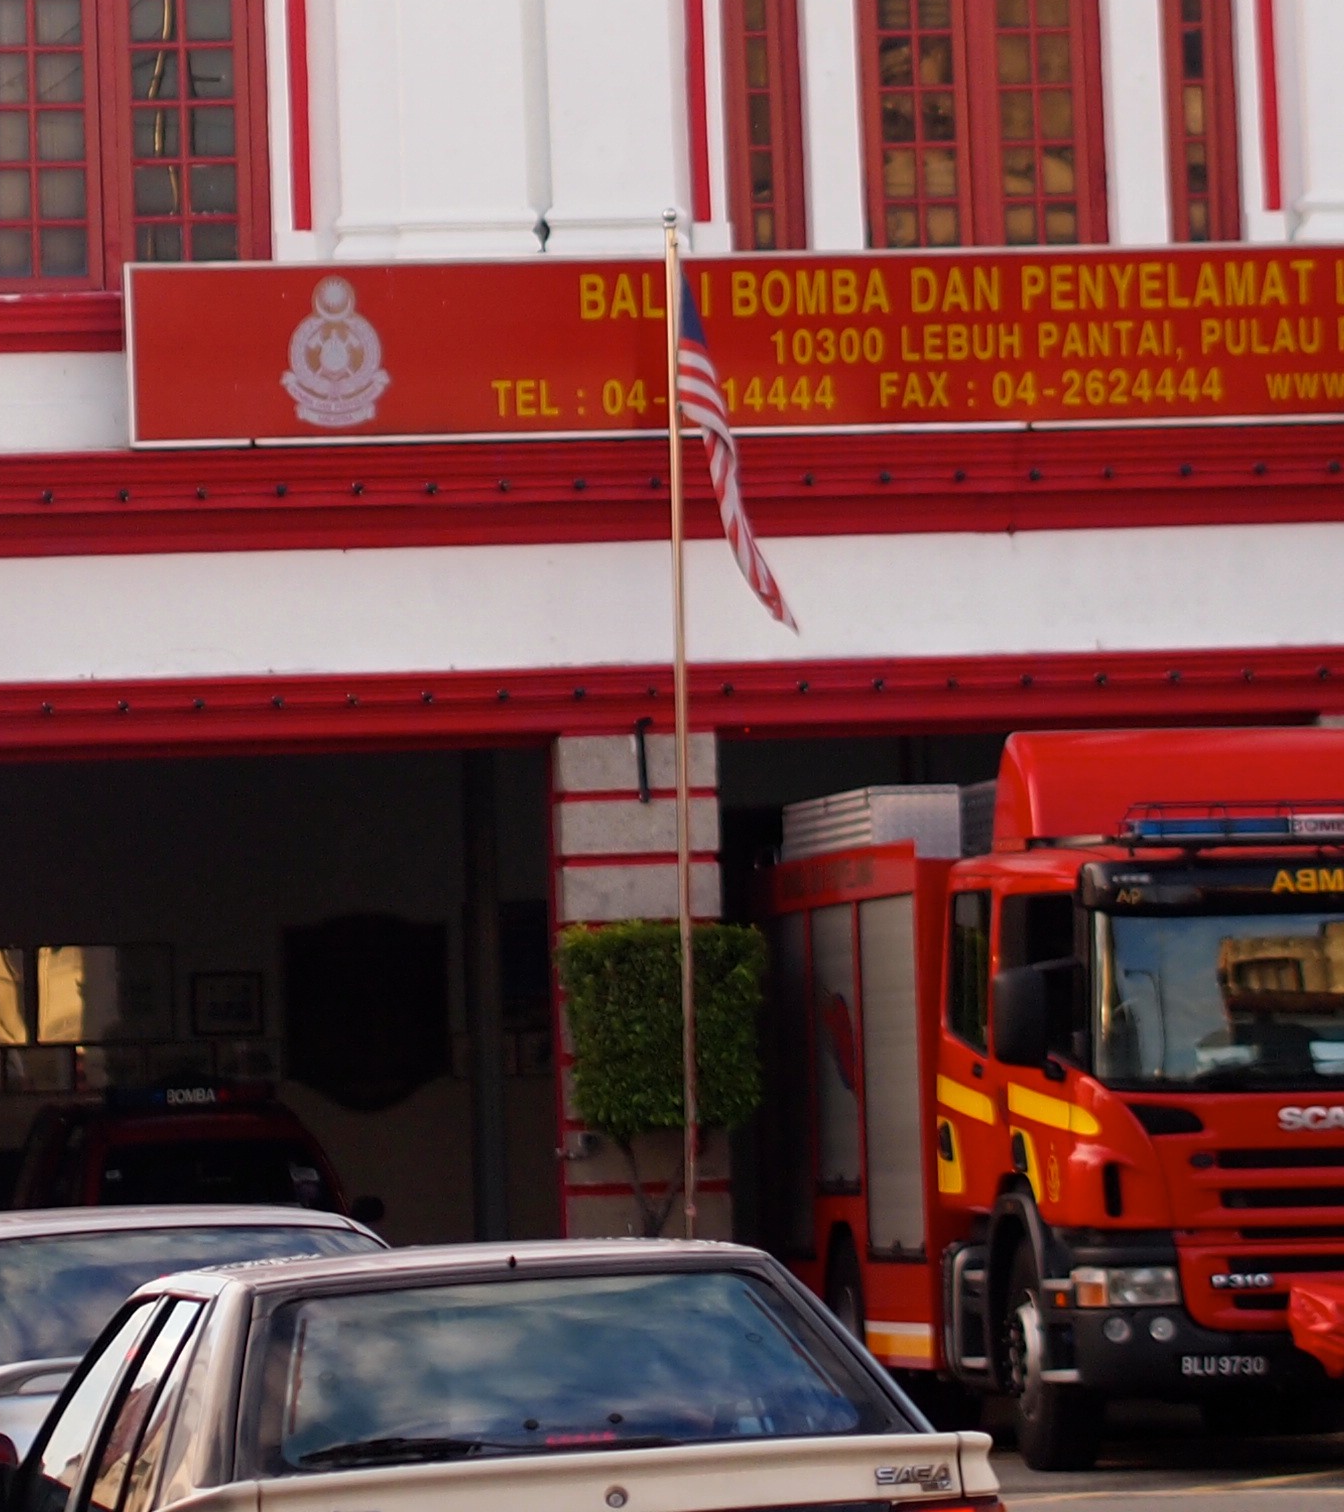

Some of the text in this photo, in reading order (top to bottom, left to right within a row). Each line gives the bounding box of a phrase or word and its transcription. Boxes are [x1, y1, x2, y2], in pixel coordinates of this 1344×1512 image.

[579, 271, 709, 321] BALI
[731, 267, 890, 317] BOMBA
[910, 265, 1000, 314] DAN
[1020, 258, 1315, 311] PENYELAMAT
[770, 326, 884, 365] 10300
[901, 322, 1022, 362] LEBUH
[1038, 319, 1183, 361] PANTAI,
[1200, 316, 1321, 356] PULAU
[490, 378, 559, 418] TEL
[879, 370, 950, 409] FAX
[991, 366, 1224, 407] 04-2624444
[166, 1087, 216, 1103] BOMBA
[1181, 1355, 1266, 1375] BLU 9730
